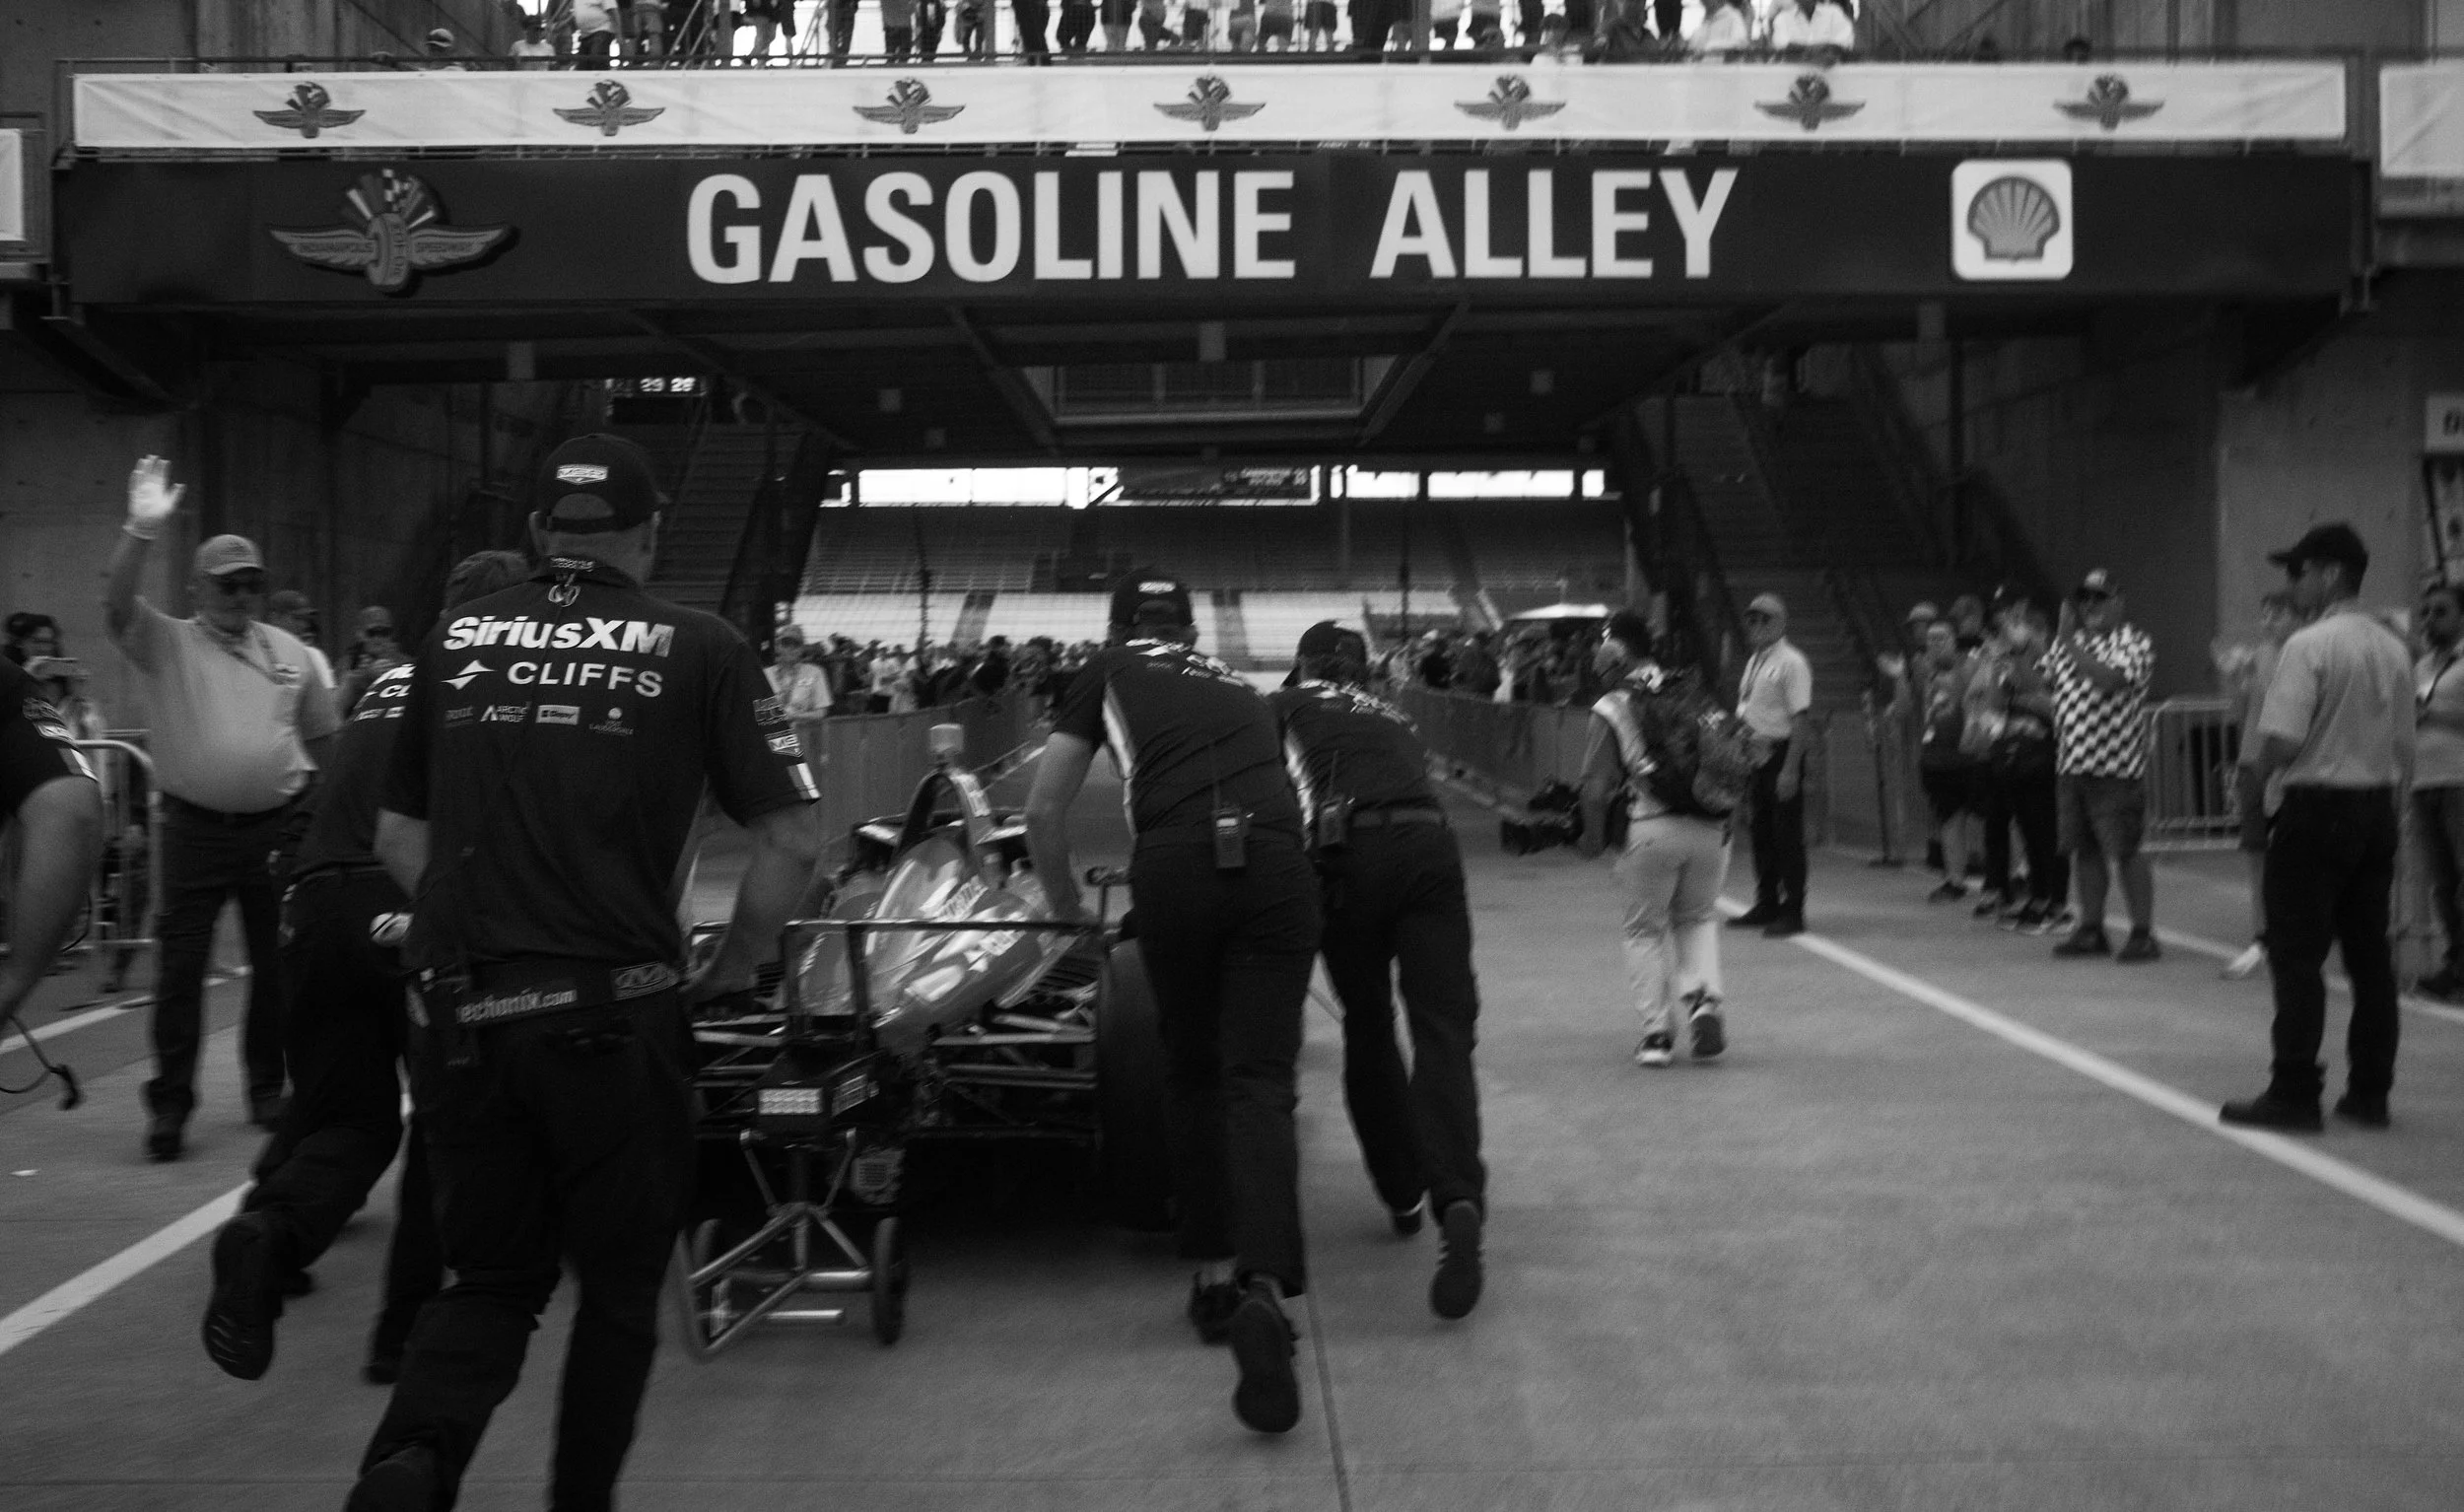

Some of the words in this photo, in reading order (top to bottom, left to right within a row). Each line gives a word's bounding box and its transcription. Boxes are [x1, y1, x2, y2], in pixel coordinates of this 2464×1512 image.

[688, 171, 1296, 284] GASOLINE
[1368, 169, 1740, 279] ALLEY
[444, 615, 676, 658] SiriusXM
[507, 660, 664, 698] CLIFFS
